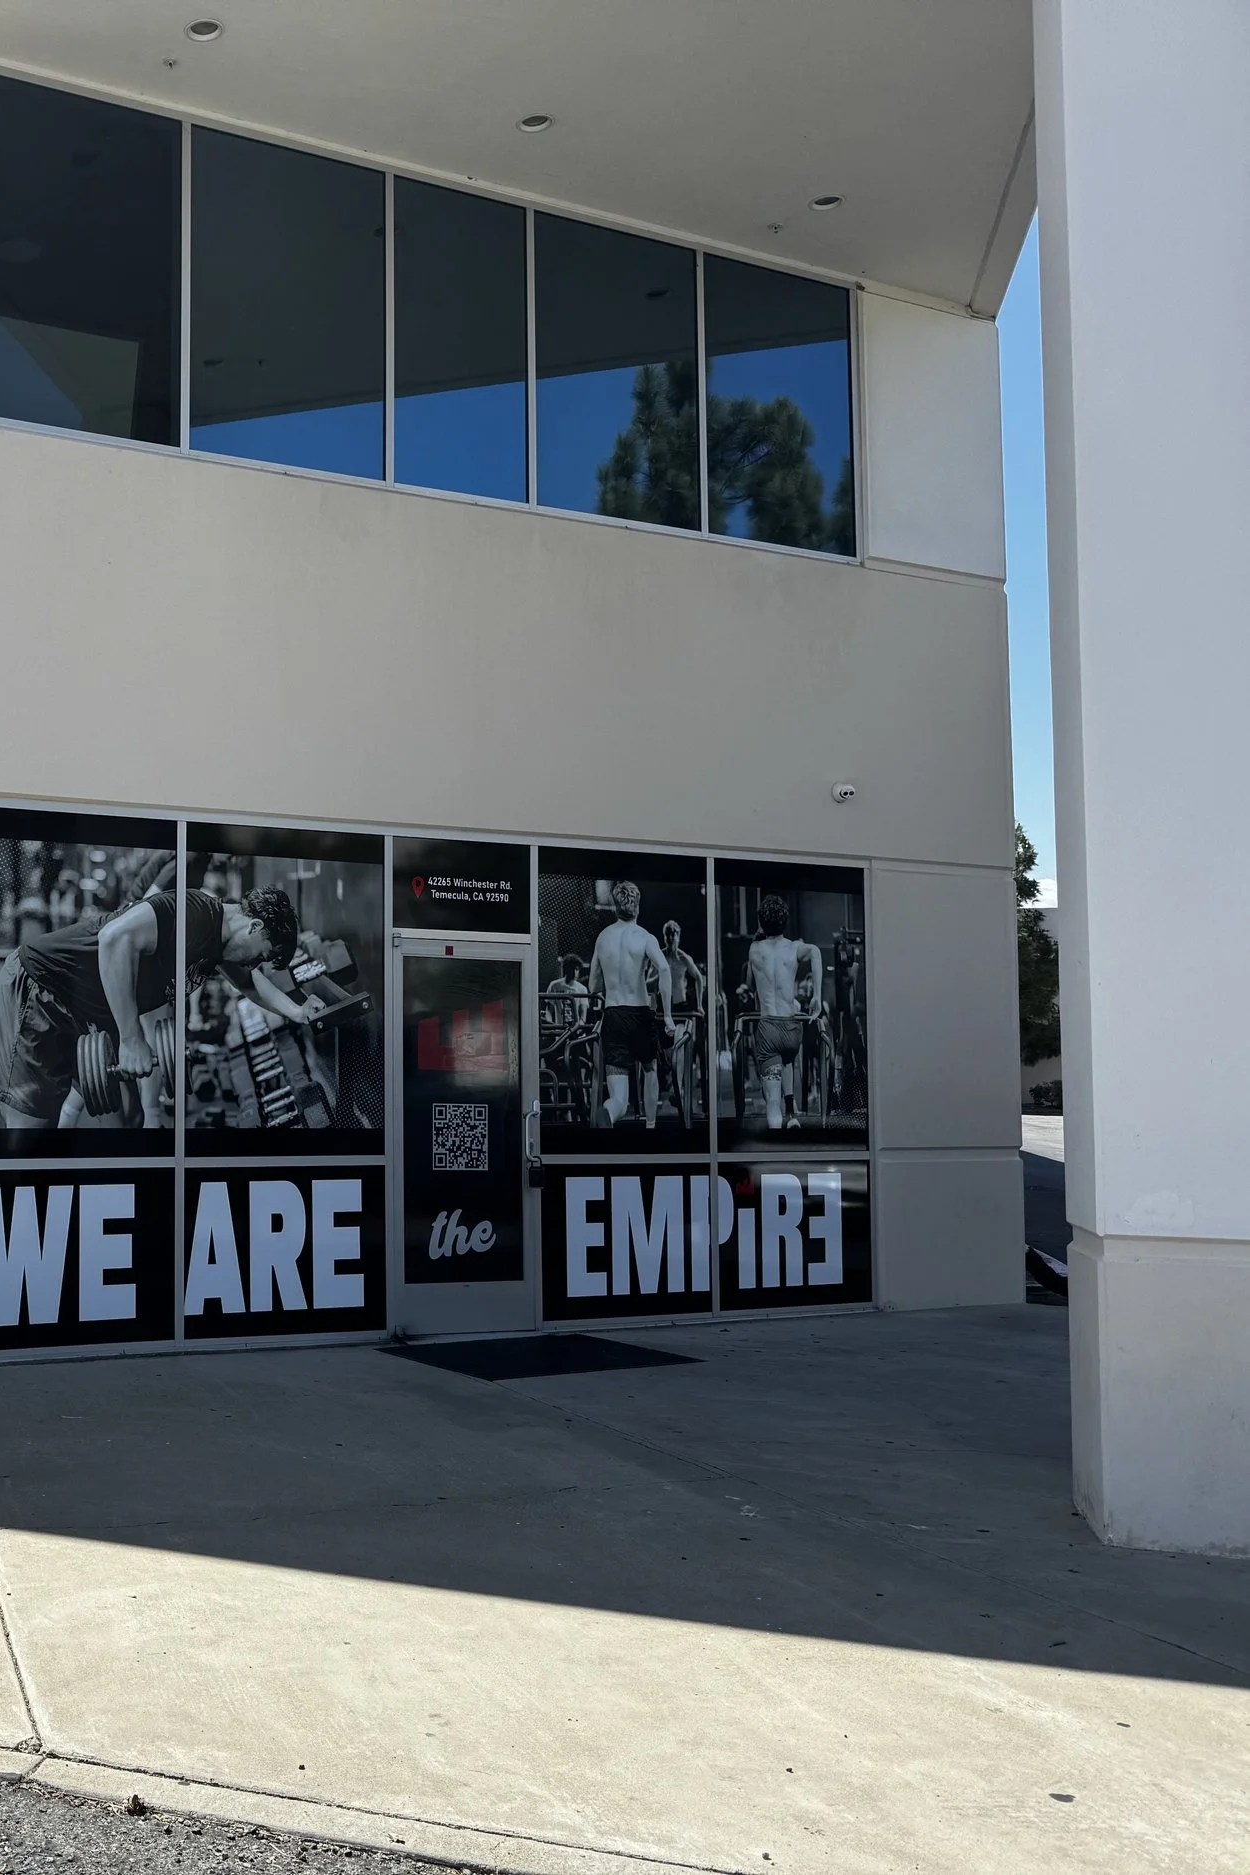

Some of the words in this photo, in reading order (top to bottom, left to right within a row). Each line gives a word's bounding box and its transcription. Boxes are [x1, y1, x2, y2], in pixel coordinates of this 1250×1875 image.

[428, 876, 451, 886] 42265
[453, 878, 498, 889] Winchester
[500, 881, 513, 890] Rd.
[431, 889, 471, 901] Temecula,
[473, 892, 484, 901] CA
[486, 893, 509, 902] 92590
[183, 1178, 365, 1316] ARE
[428, 1208, 497, 1260] the
